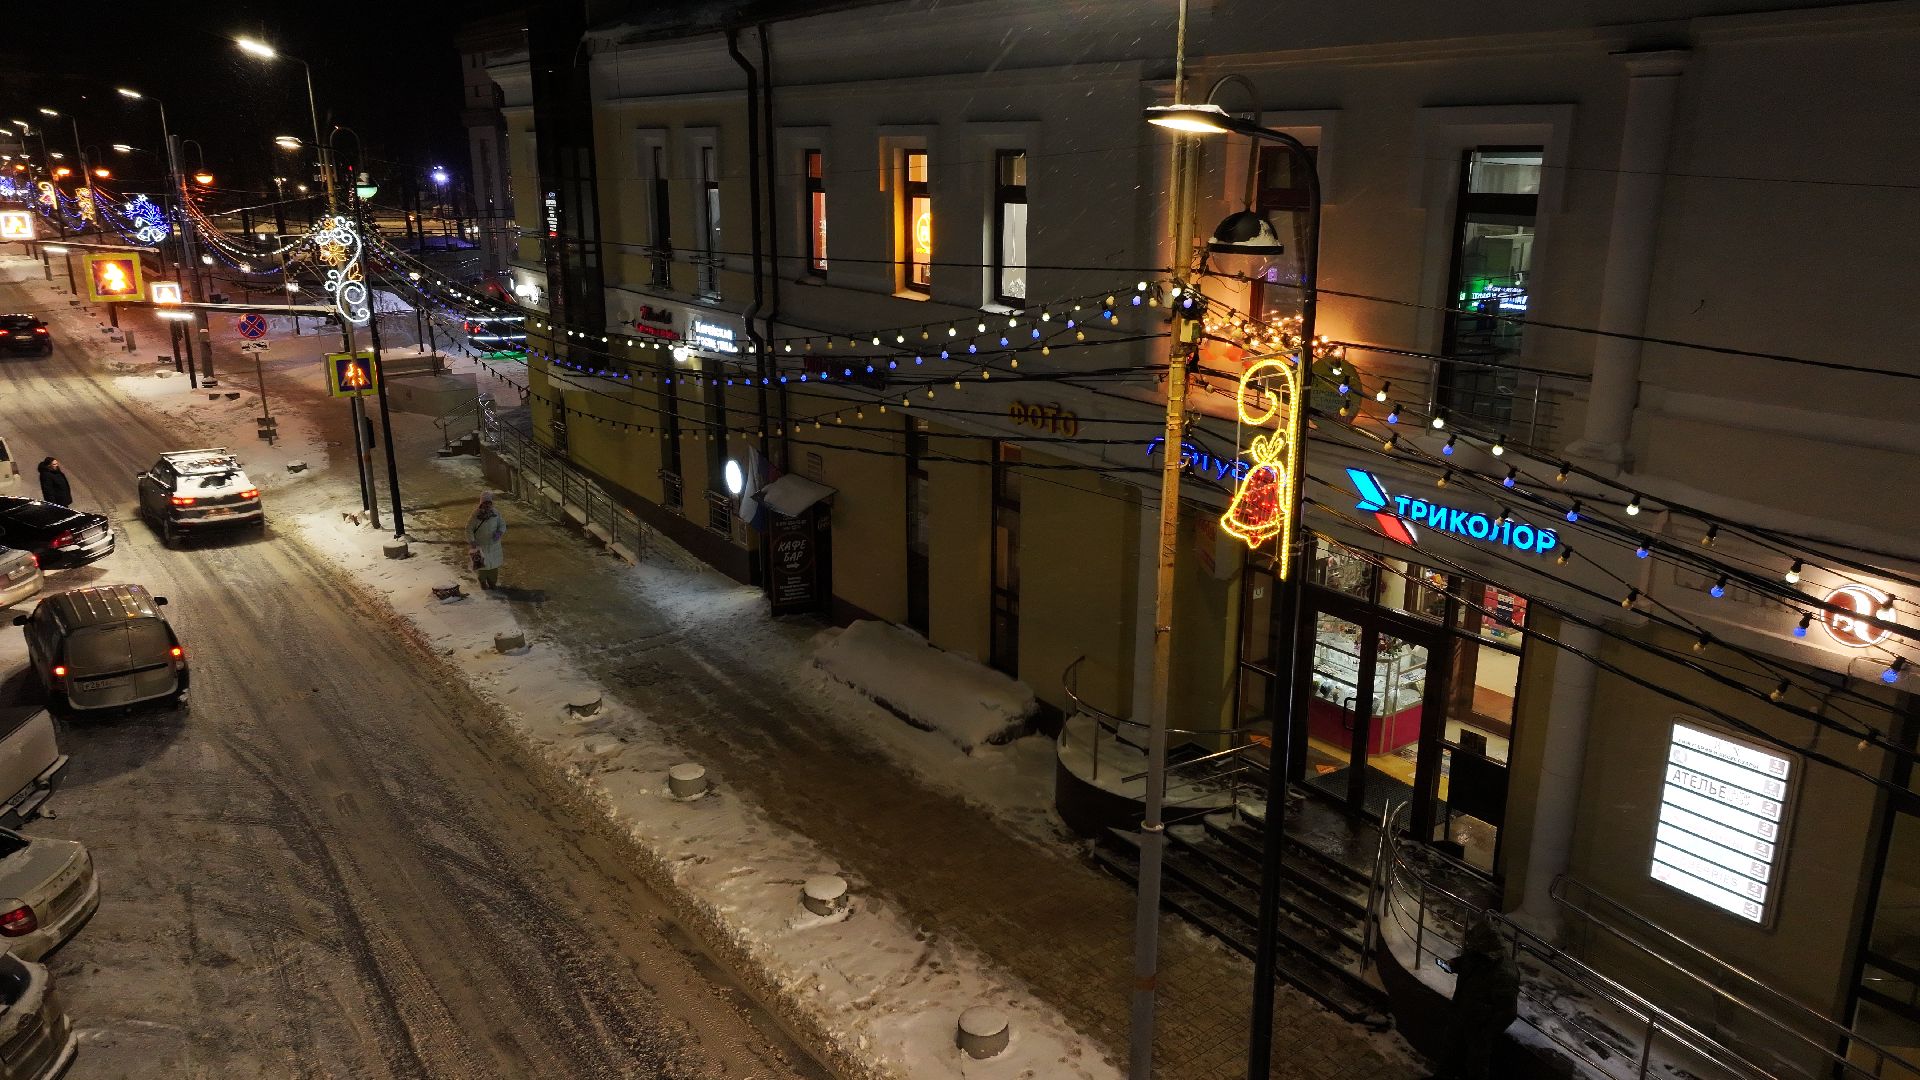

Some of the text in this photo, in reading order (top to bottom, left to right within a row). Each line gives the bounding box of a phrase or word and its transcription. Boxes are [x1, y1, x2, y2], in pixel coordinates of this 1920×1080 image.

[1008, 401, 1076, 437] ФОТО
[1394, 495, 1557, 554] ТРИКОЛОР
[777, 539, 807, 552] КАФЕ
[783, 550, 804, 562] БАР
[1672, 768, 1727, 799] АТЕЛЬЕ
